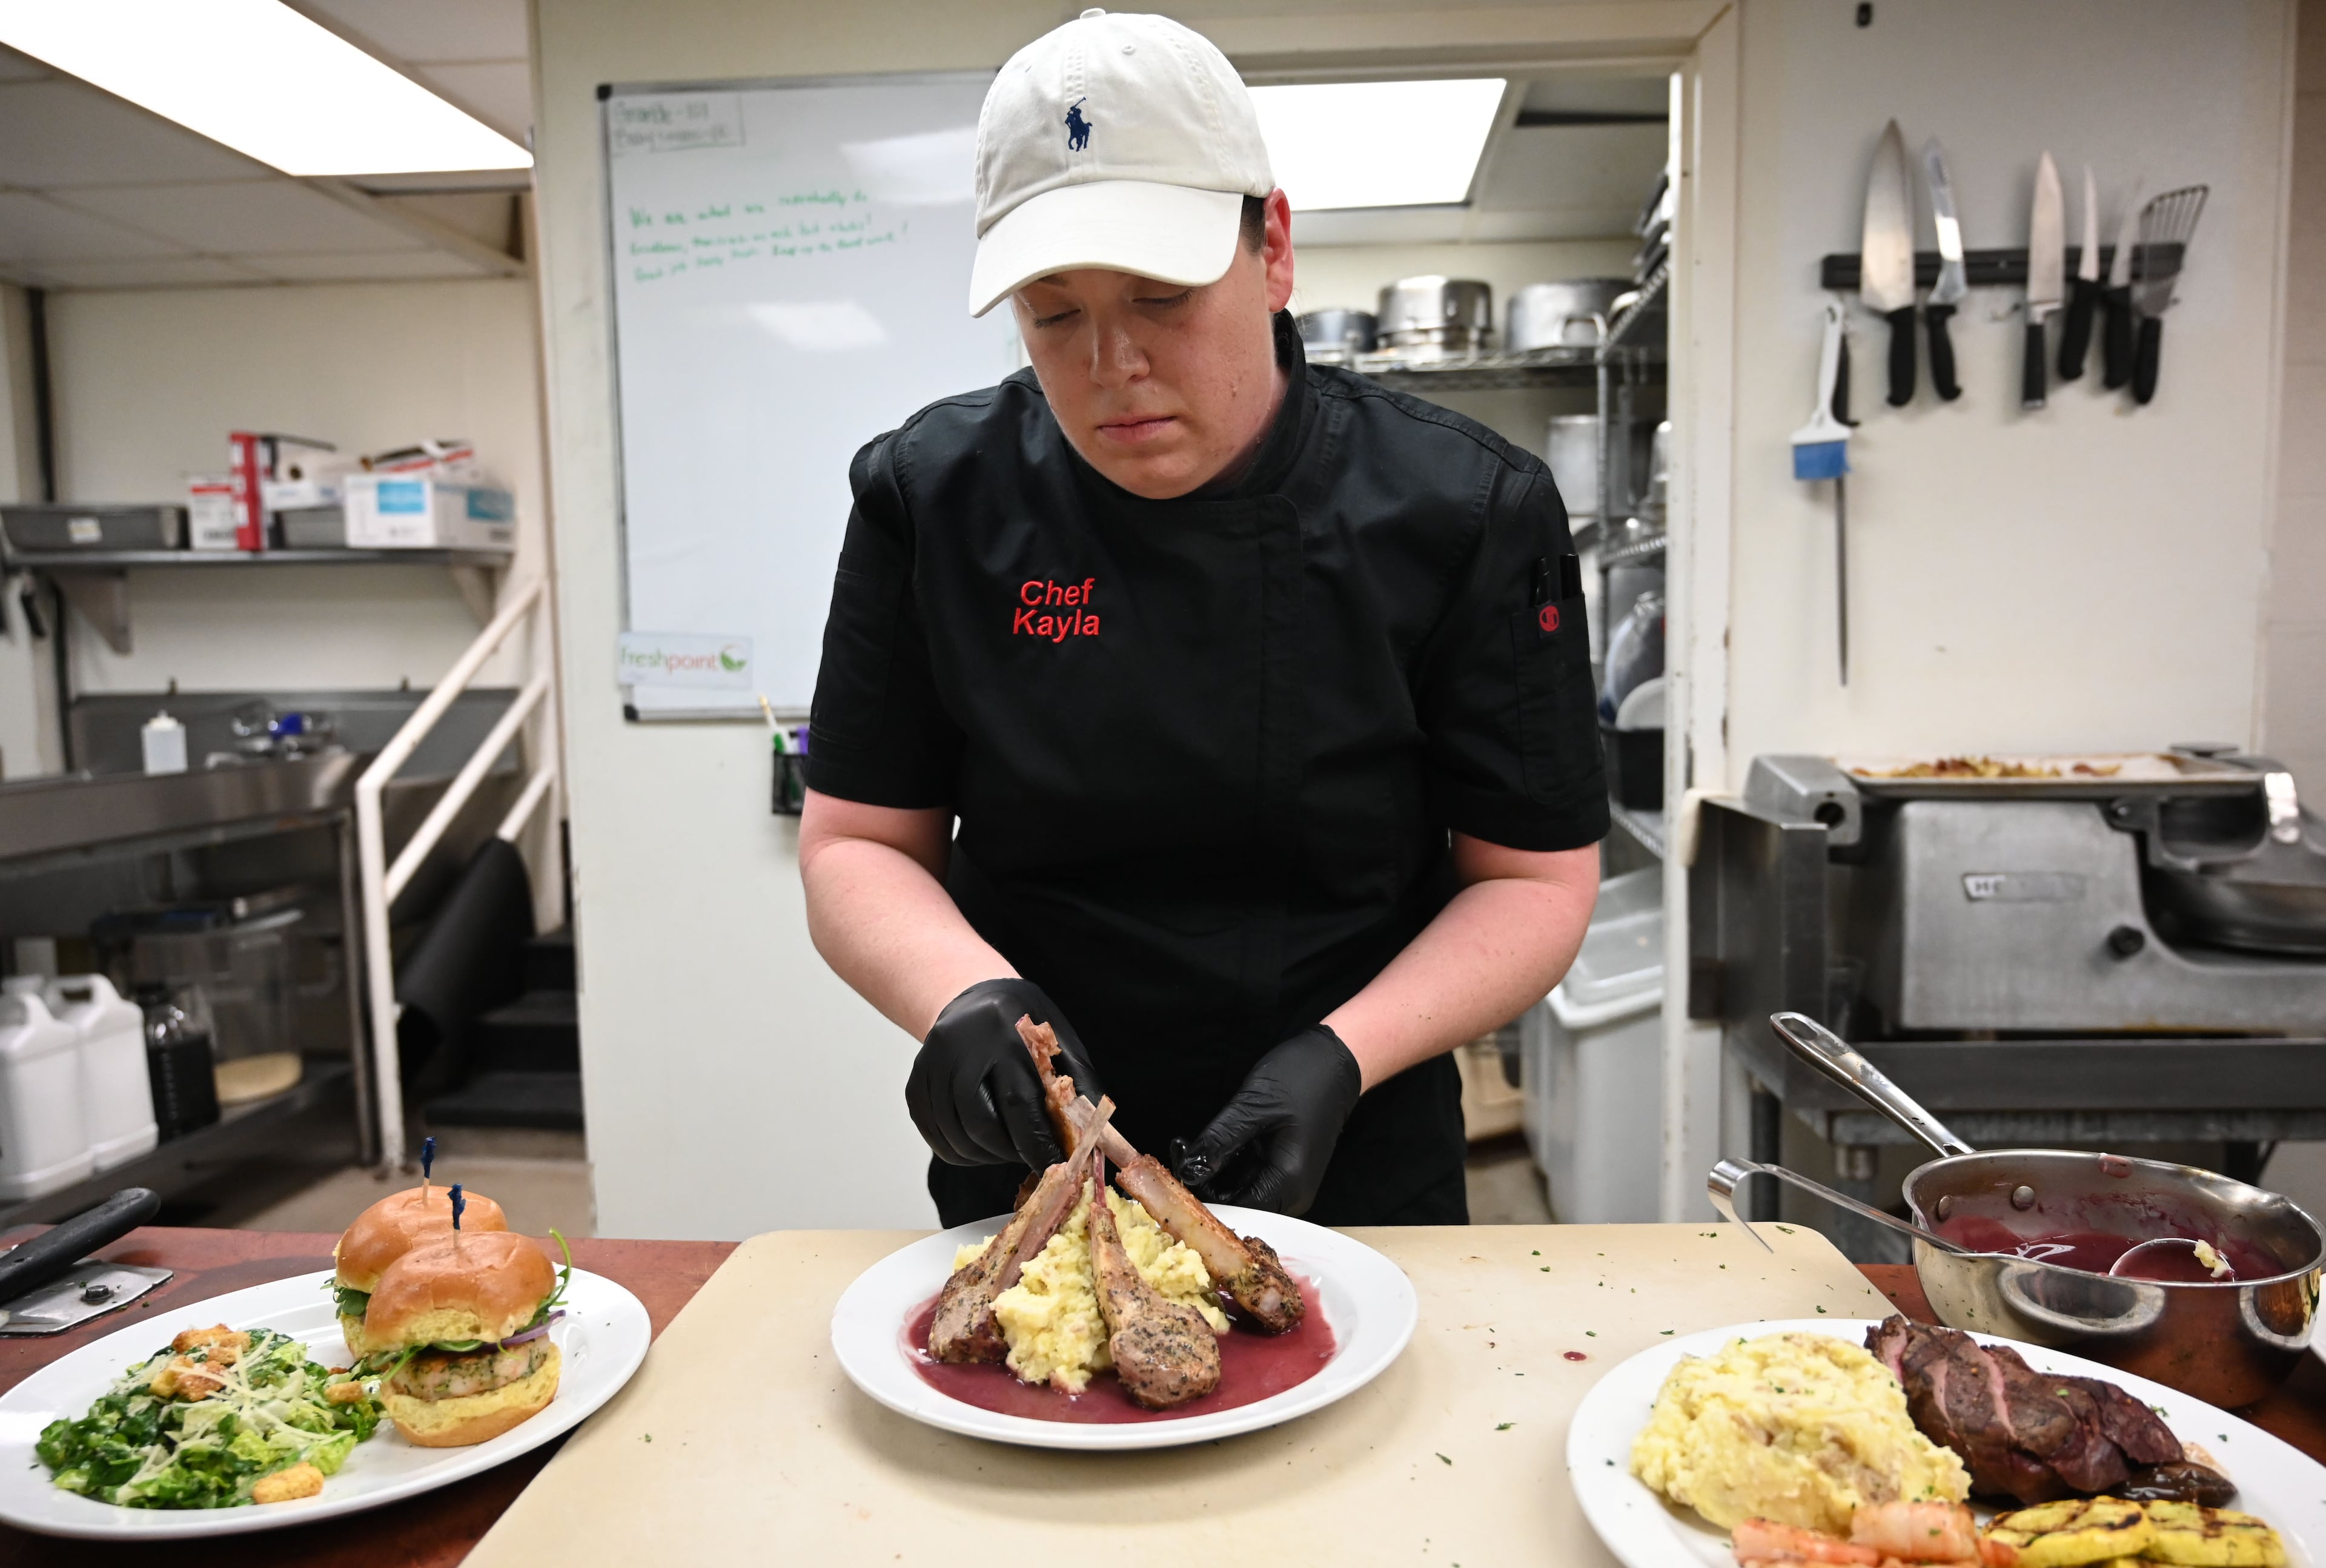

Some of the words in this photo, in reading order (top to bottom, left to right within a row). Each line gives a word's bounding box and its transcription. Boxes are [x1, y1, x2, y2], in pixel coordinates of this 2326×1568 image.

[1021, 578, 1095, 606] Chef
[1013, 607, 1100, 643] Kayla
[620, 646, 719, 674] freshpoint
